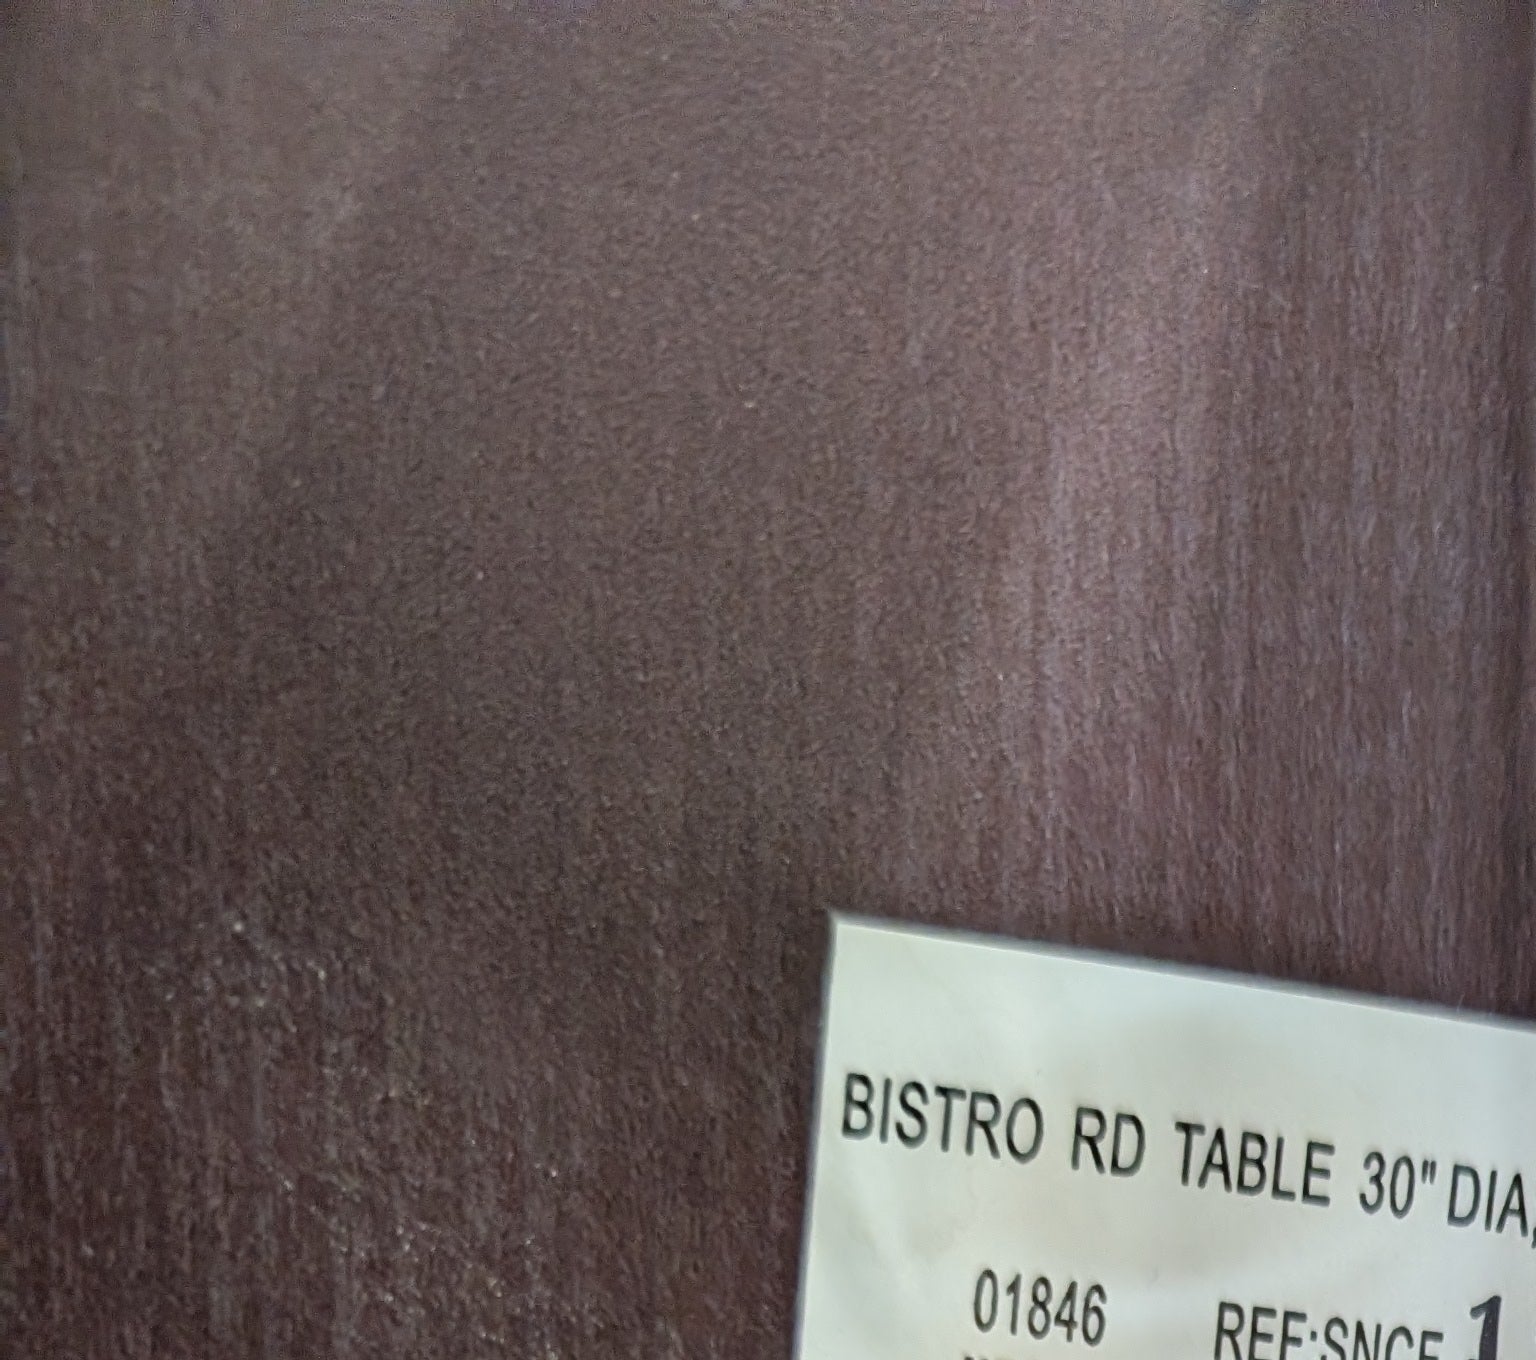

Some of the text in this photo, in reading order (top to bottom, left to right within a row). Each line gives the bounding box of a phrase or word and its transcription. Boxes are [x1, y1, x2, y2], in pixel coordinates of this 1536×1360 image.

[842, 1072, 1044, 1165] BISTRO
[1071, 1104, 1145, 1178] RD
[1175, 1120, 1336, 1207] TABLE
[973, 1268, 1107, 1347] 01846
